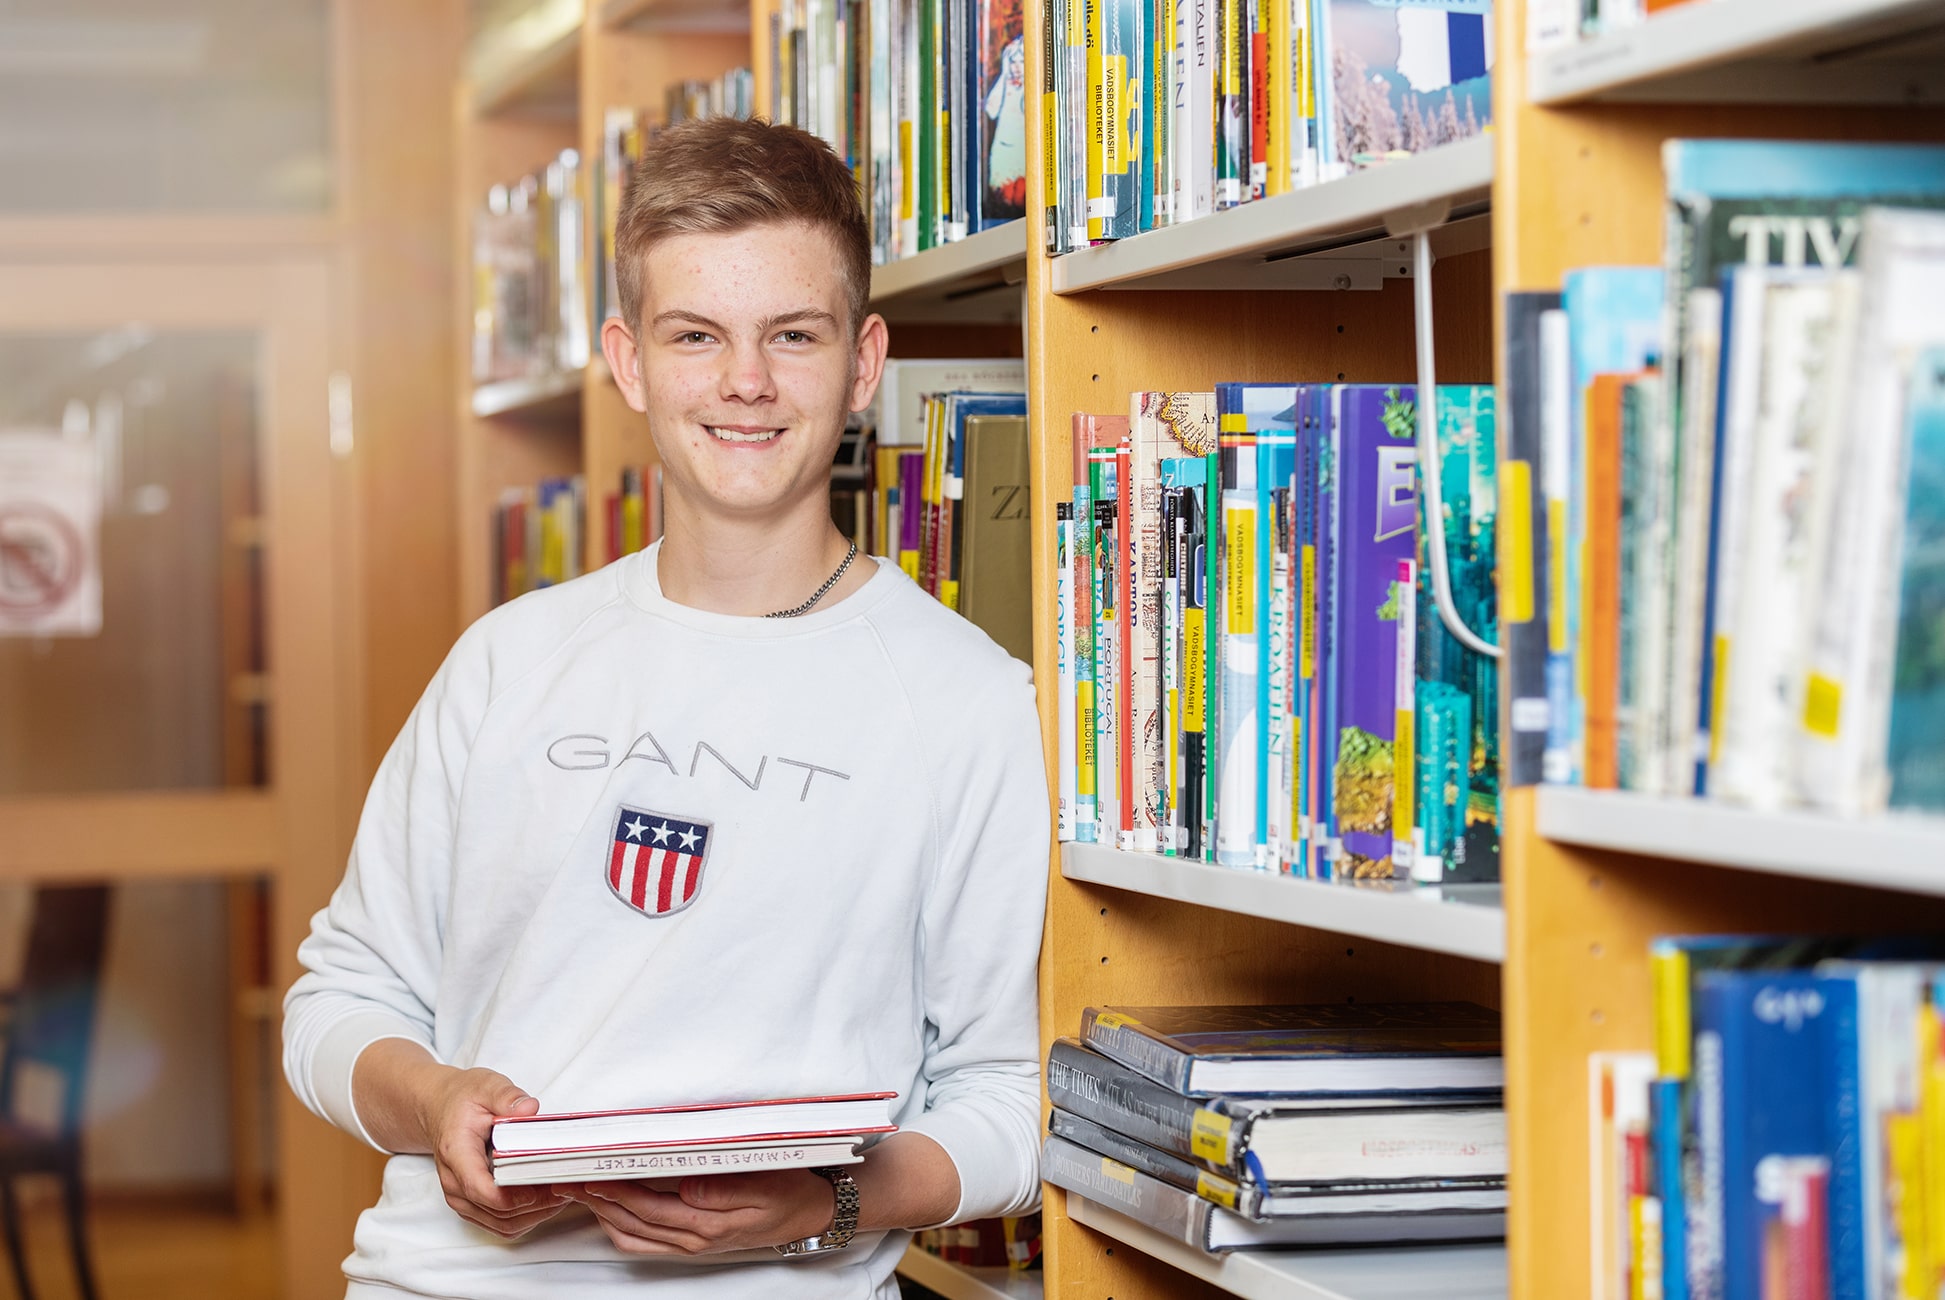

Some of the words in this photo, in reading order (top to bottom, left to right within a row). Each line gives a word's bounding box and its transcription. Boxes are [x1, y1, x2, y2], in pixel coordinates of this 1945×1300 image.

[1095, 84, 1104, 145] BIBLIOTEKET
[1106, 68, 1116, 161] VADSBOGYMNASIET
[1236, 524, 1244, 617] VADSBOGYMNASIET
[1105, 638, 1113, 740] PORTUGAL
[1187, 625, 1199, 717] VADSBOGYMNASIET
[1270, 588, 1284, 756] KROATIEN
[547, 731, 851, 802] GANT
[1084, 708, 1093, 766] BIBLIOTEKET
[1050, 1059, 1069, 1091] THE
[1072, 1067, 1101, 1104] TIMES
[1103, 1078, 1135, 1116] ATLAS
